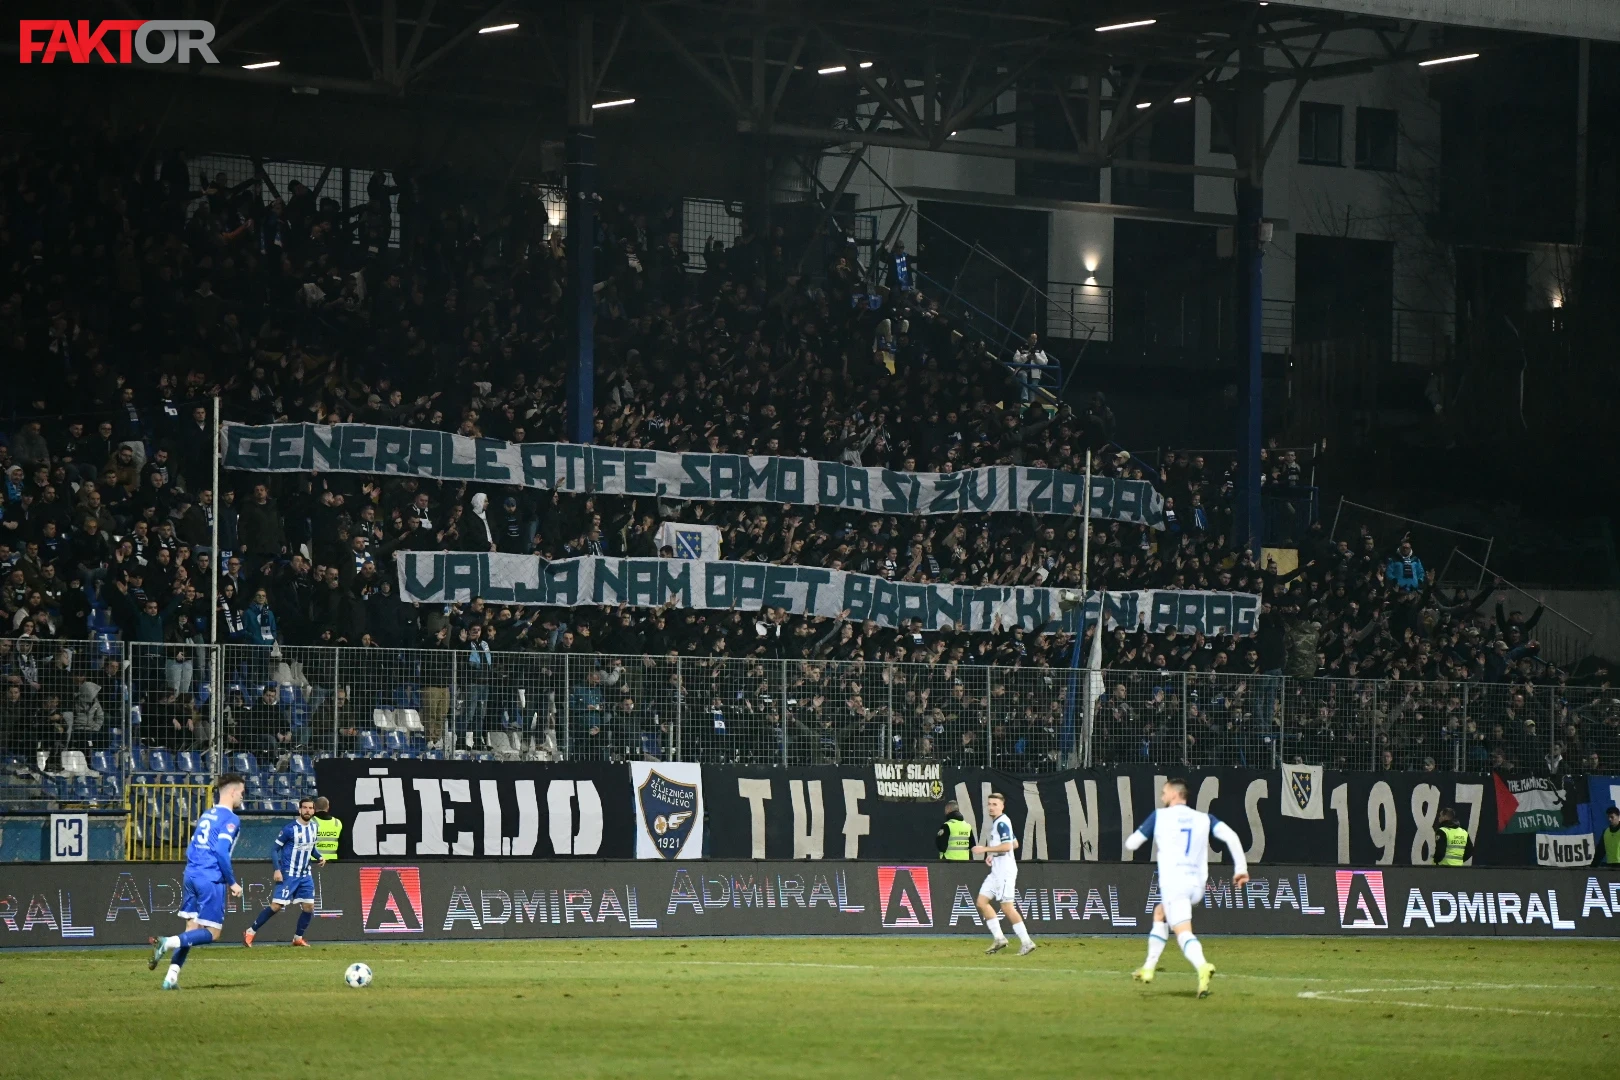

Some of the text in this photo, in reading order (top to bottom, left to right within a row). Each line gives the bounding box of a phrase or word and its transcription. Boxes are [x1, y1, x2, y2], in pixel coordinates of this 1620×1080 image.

[226, 424, 512, 480] GENERALE
[680, 454, 805, 503] SAMO
[818, 463, 871, 508] DA
[405, 553, 580, 604] VALJA
[594, 559, 691, 607] NAM
[705, 562, 830, 613] OPET
[652, 789, 690, 808] SARAJEVO
[1507, 780, 1521, 792] THE
[56, 819, 82, 857] C3
[197, 819, 211, 844] 3
[1330, 781, 1483, 866] 1987
[1519, 813, 1560, 829] INTIFADA
[657, 837, 680, 849] 1921
[1180, 828, 1193, 857] 7
[105, 872, 344, 921] ADIRL
[281, 888, 289, 898] 17
[442, 885, 658, 931] ADMIRAL
[667, 869, 866, 915] ADMIRAL
[949, 885, 1137, 927] AMIRAL
[1403, 888, 1576, 930] ADMIRAL
